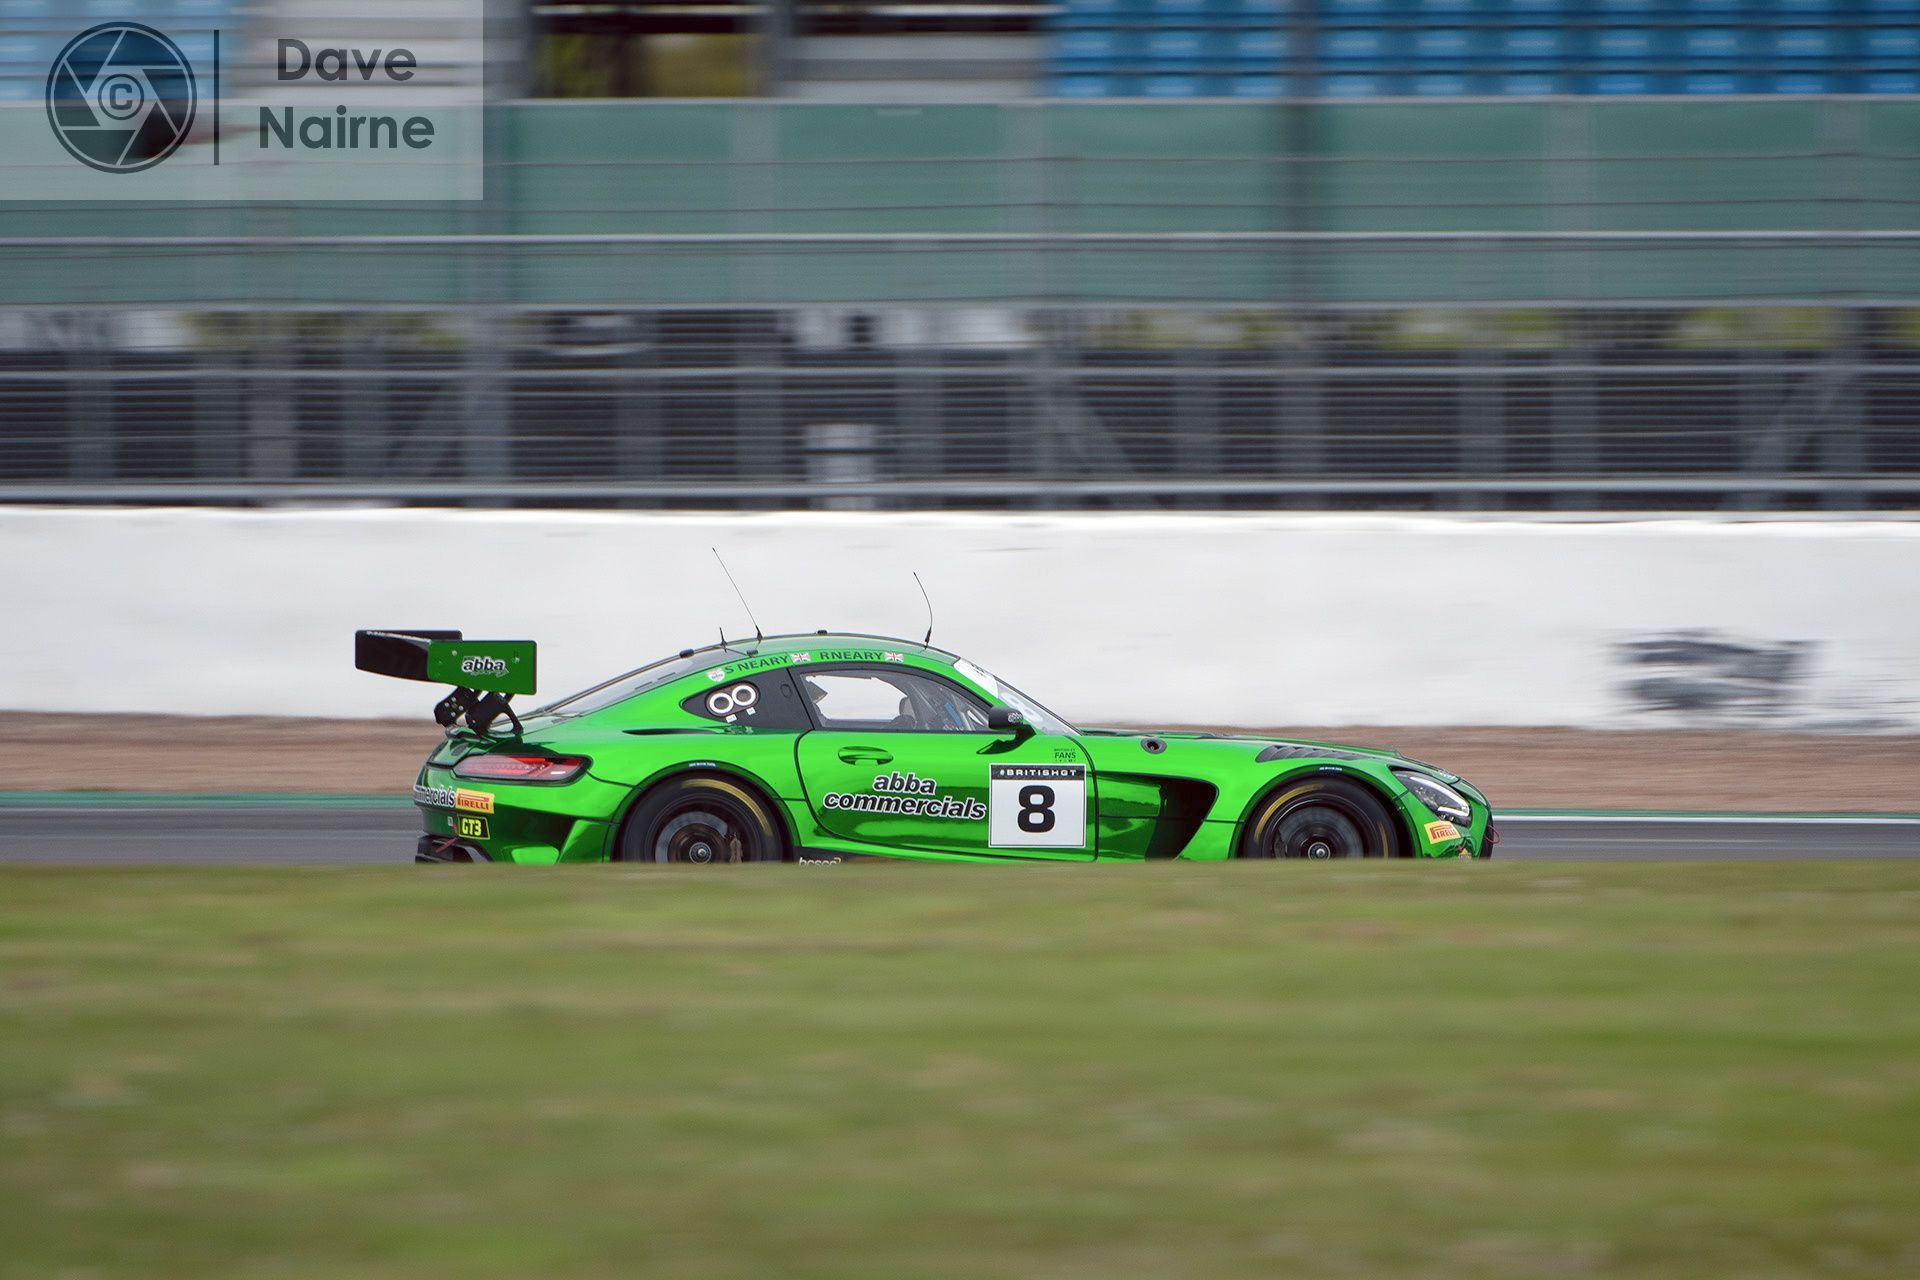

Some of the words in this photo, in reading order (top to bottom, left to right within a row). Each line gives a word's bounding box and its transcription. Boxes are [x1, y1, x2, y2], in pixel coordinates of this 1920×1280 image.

[462, 656, 505, 673] abba
[737, 655, 790, 671] NEARY
[873, 772, 936, 794] abba
[457, 793, 491, 811] PIRELLI
[823, 793, 987, 819] commercials
[1017, 785, 1056, 833] 8
[461, 817, 482, 837] GT3
[1429, 825, 1458, 840] PIRELLI
